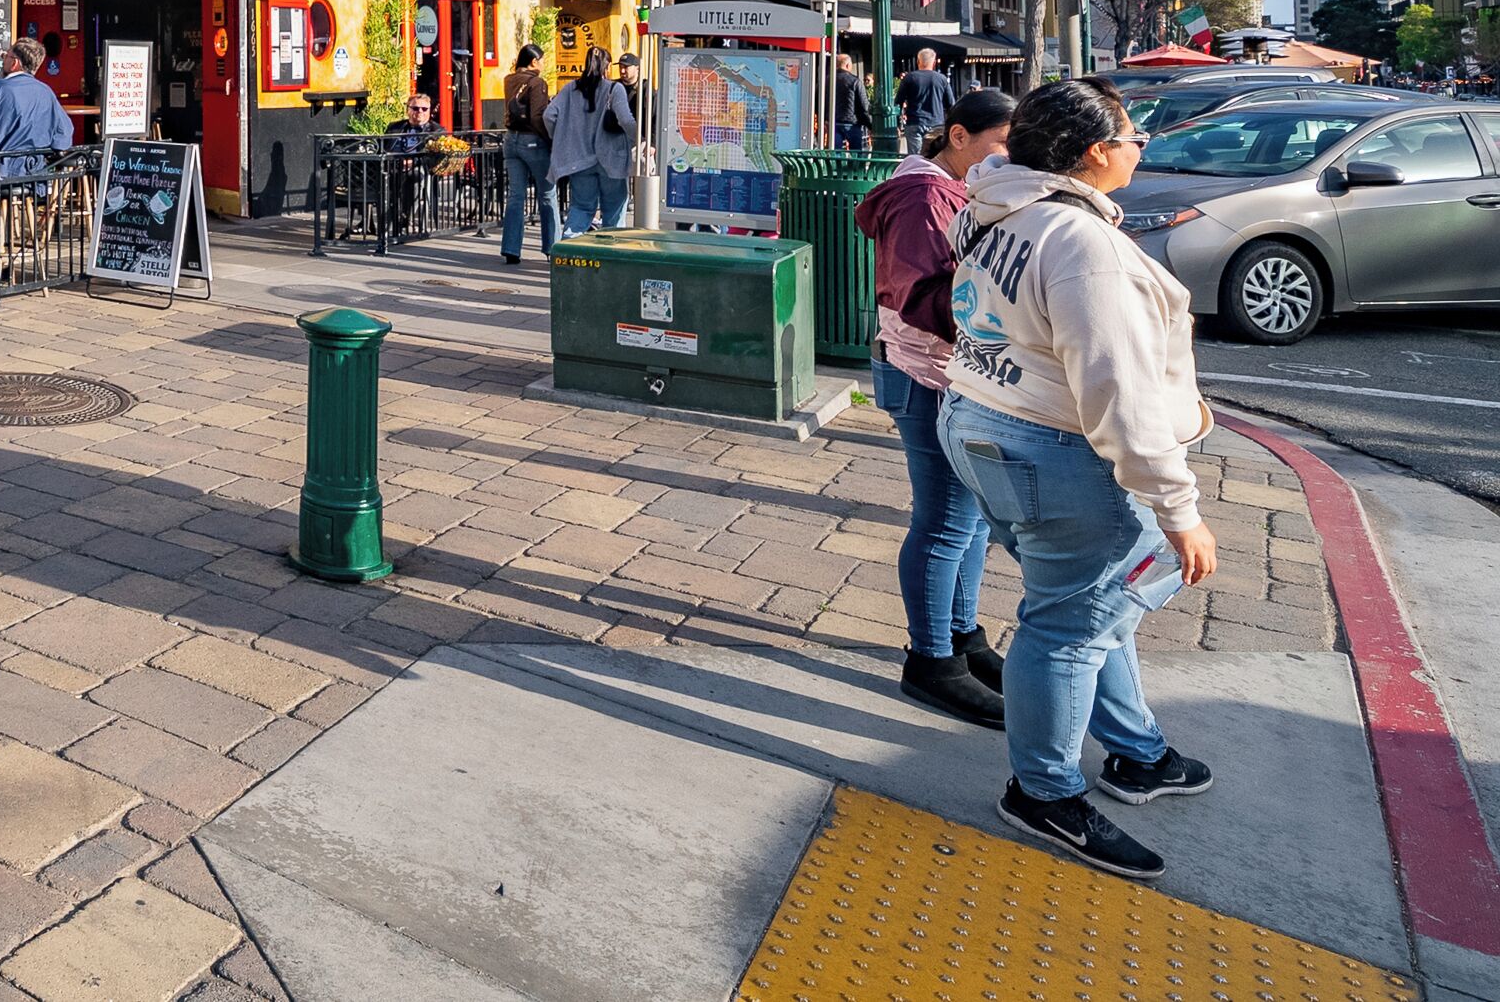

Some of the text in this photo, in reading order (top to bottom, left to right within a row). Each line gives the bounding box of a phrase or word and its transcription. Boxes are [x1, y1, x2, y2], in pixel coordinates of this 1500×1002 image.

[699, 11, 771, 26] LITTLE ITALY
[417, 23, 436, 34] GUINNESS
[121, 62, 143, 70] ALCOHOLIC
[570, 64, 584, 73] AL
[122, 81, 131, 89] PUB
[111, 110, 141, 118] CONSUMPTION
[111, 155, 125, 170] PUB
[112, 170, 131, 185] HOUSE
[133, 172, 150, 186] MADE
[126, 189, 143, 200] PORK
[129, 202, 140, 210] OR
[116, 210, 151, 226] CHICKEN
[113, 251, 126, 259] HOT
[140, 260, 170, 270] STELLA
